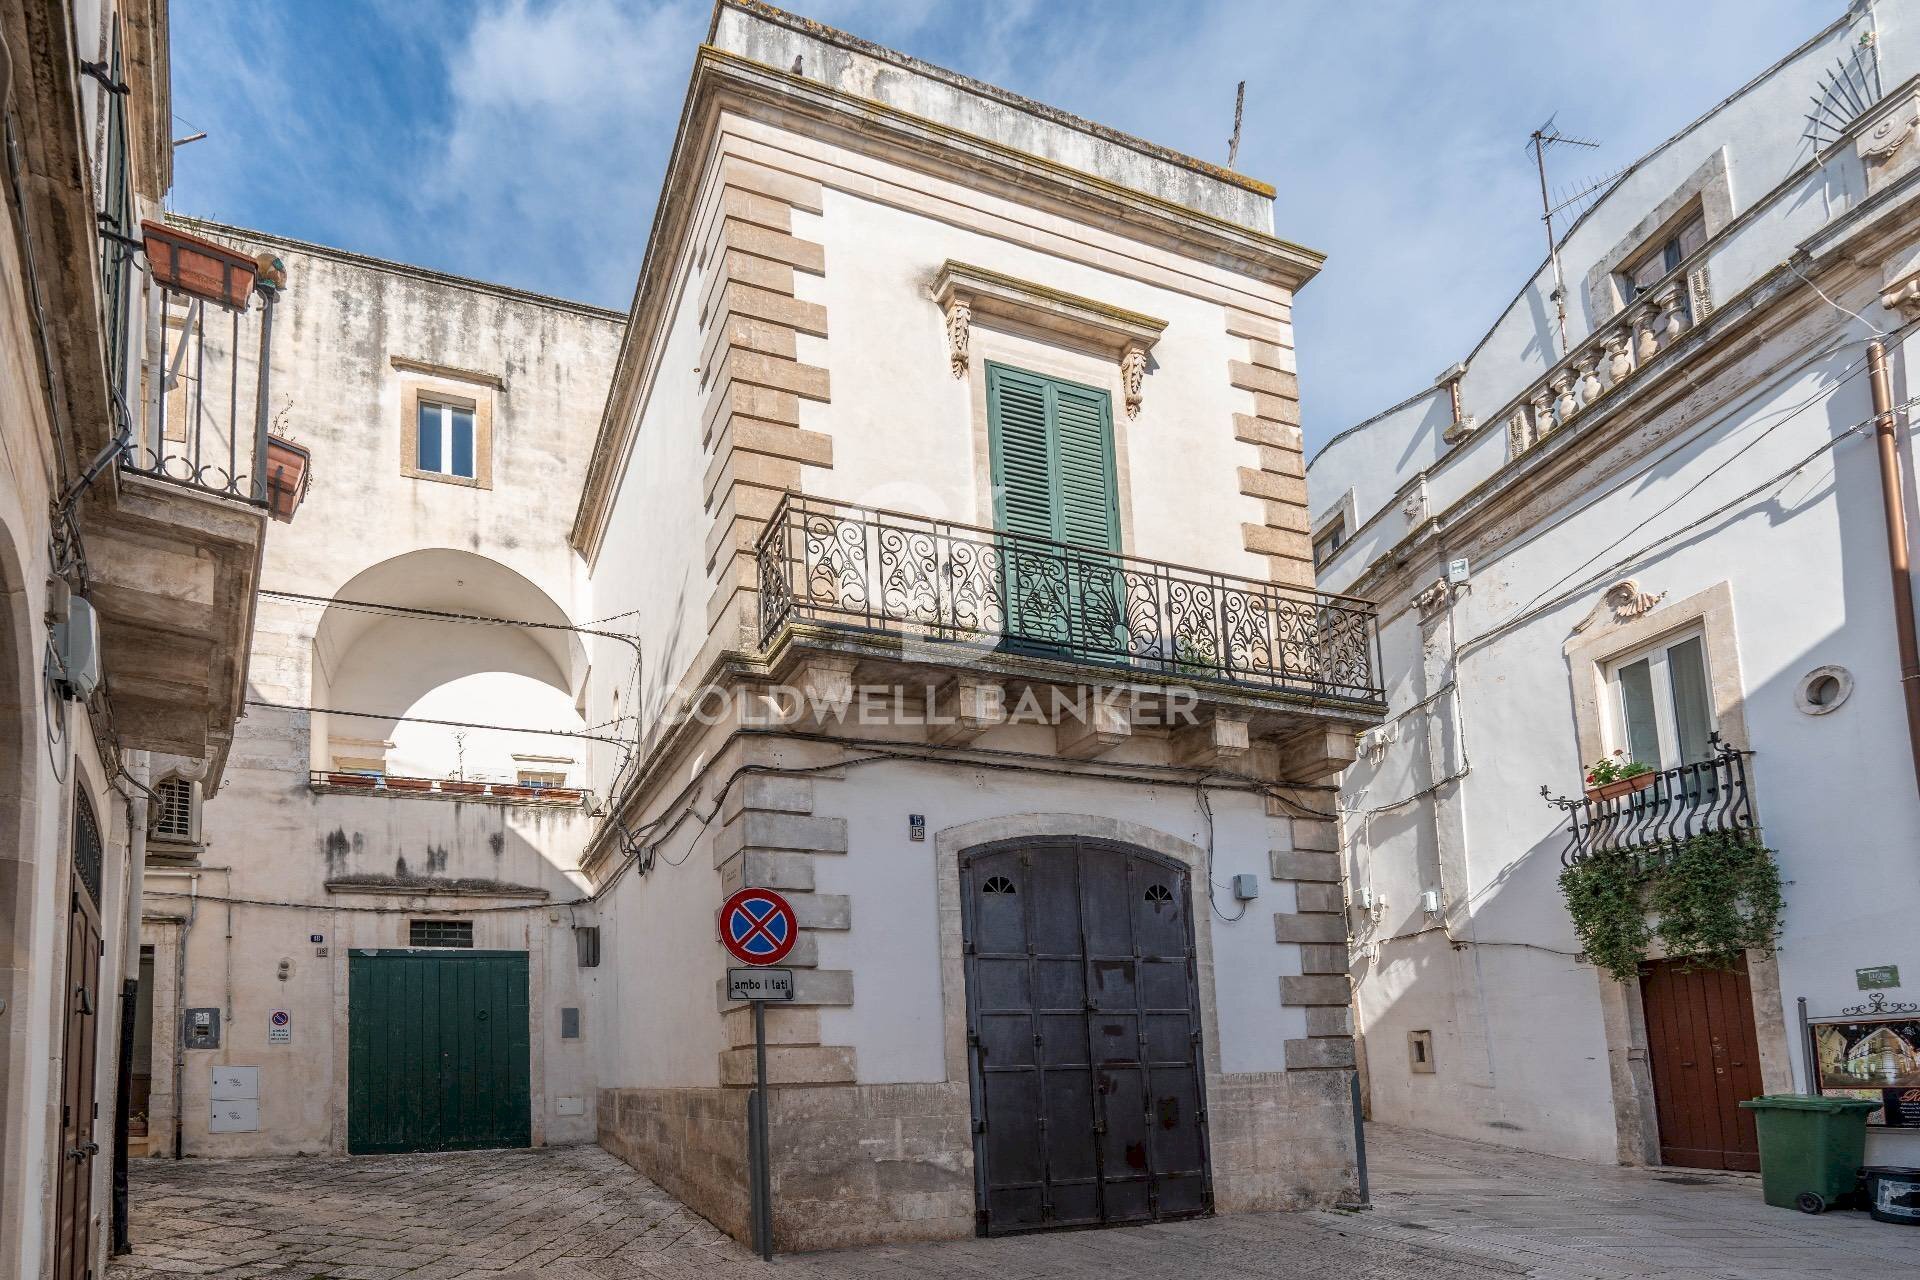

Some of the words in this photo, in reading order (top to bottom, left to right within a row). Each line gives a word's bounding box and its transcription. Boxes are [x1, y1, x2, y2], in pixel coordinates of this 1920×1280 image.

[914, 828, 922, 836] 15
[734, 979, 761, 990] ambo
[772, 979, 788, 990] lati
